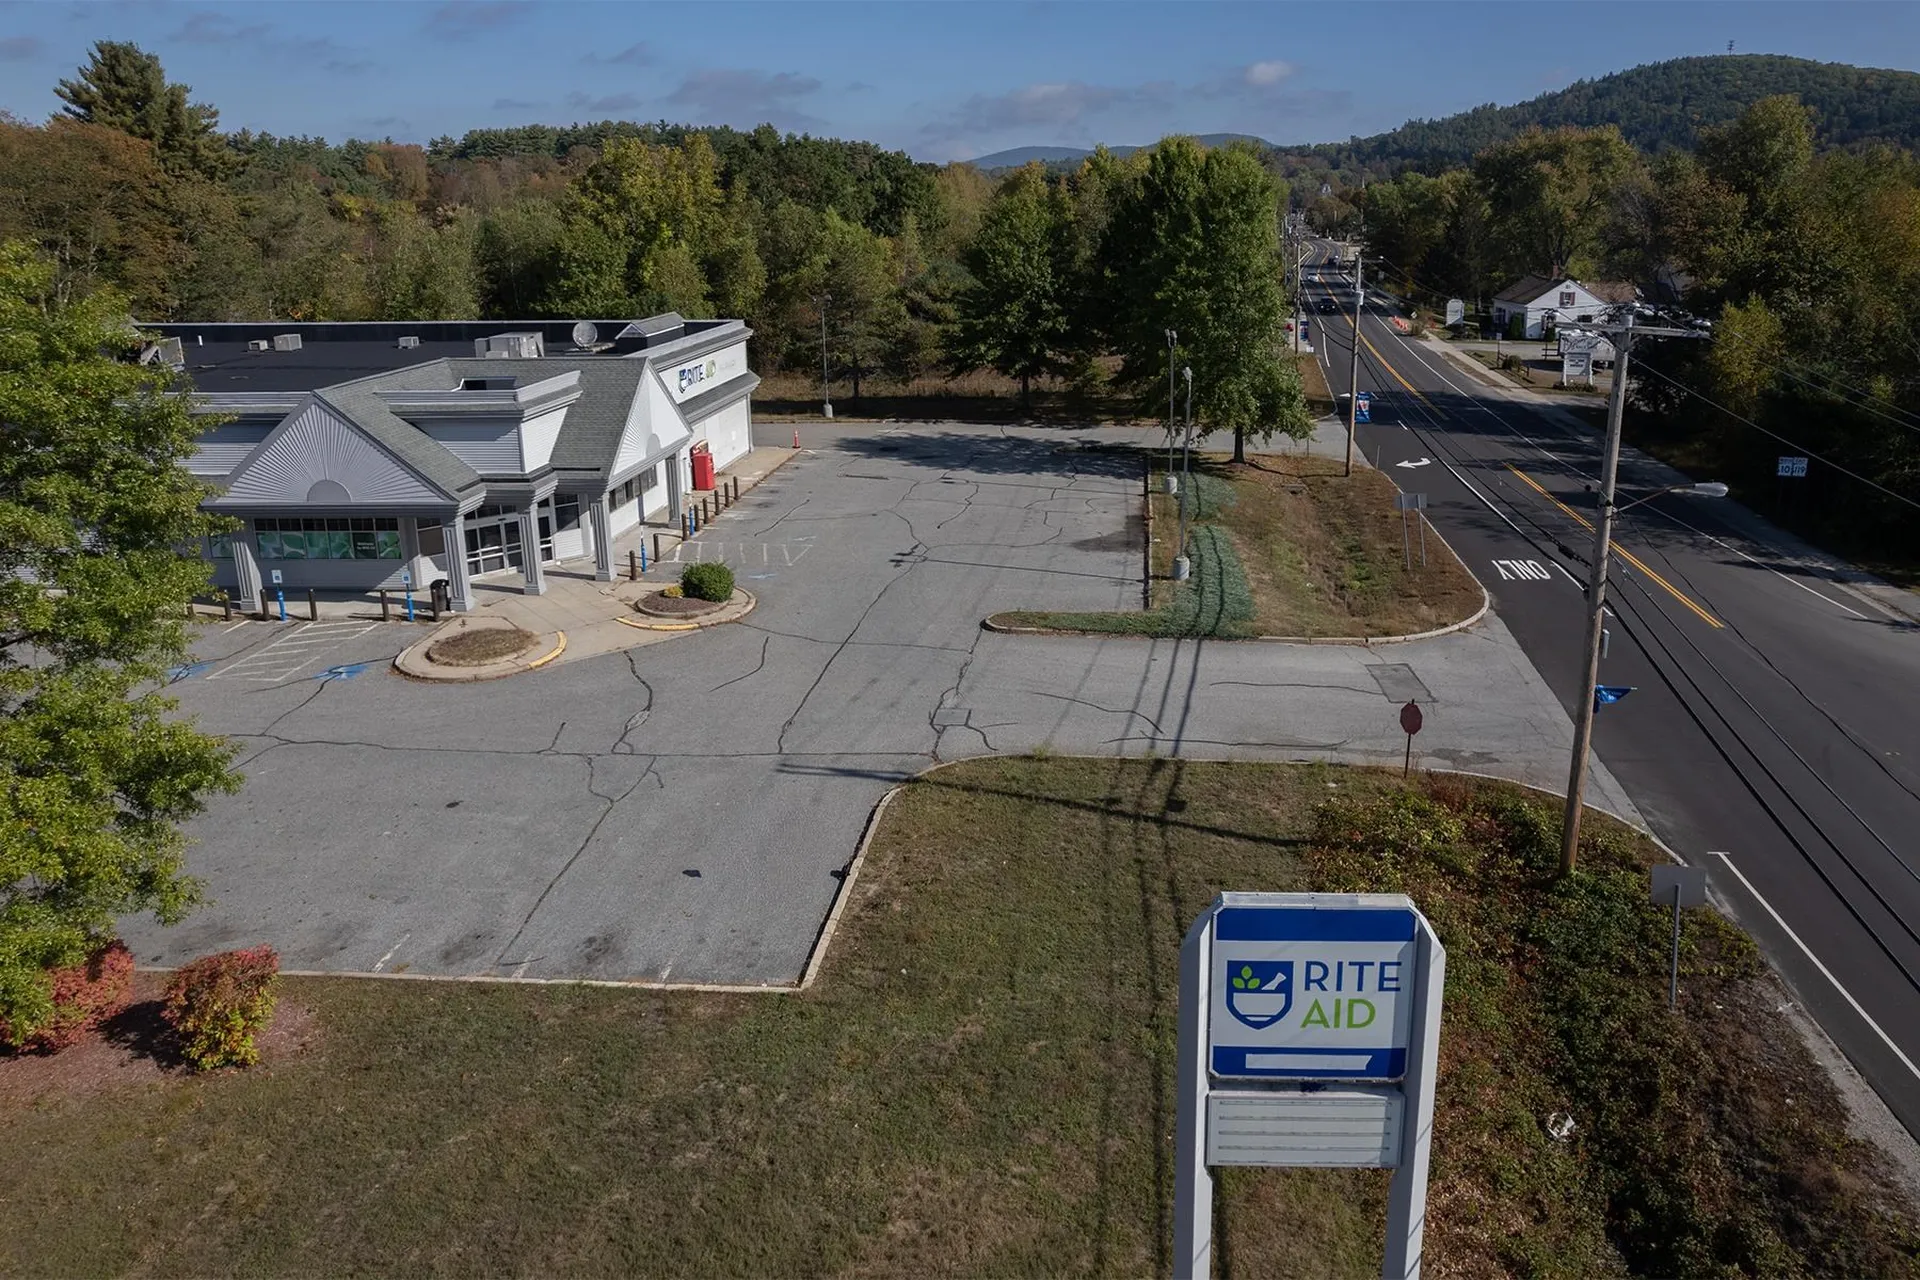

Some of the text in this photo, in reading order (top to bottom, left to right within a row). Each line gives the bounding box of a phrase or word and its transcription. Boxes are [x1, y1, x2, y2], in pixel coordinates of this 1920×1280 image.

[687, 364, 705, 386] RITE
[1491, 559, 1551, 580] ONLY
[1304, 960, 1402, 992] RITE
[1300, 998, 1376, 1029] AID
